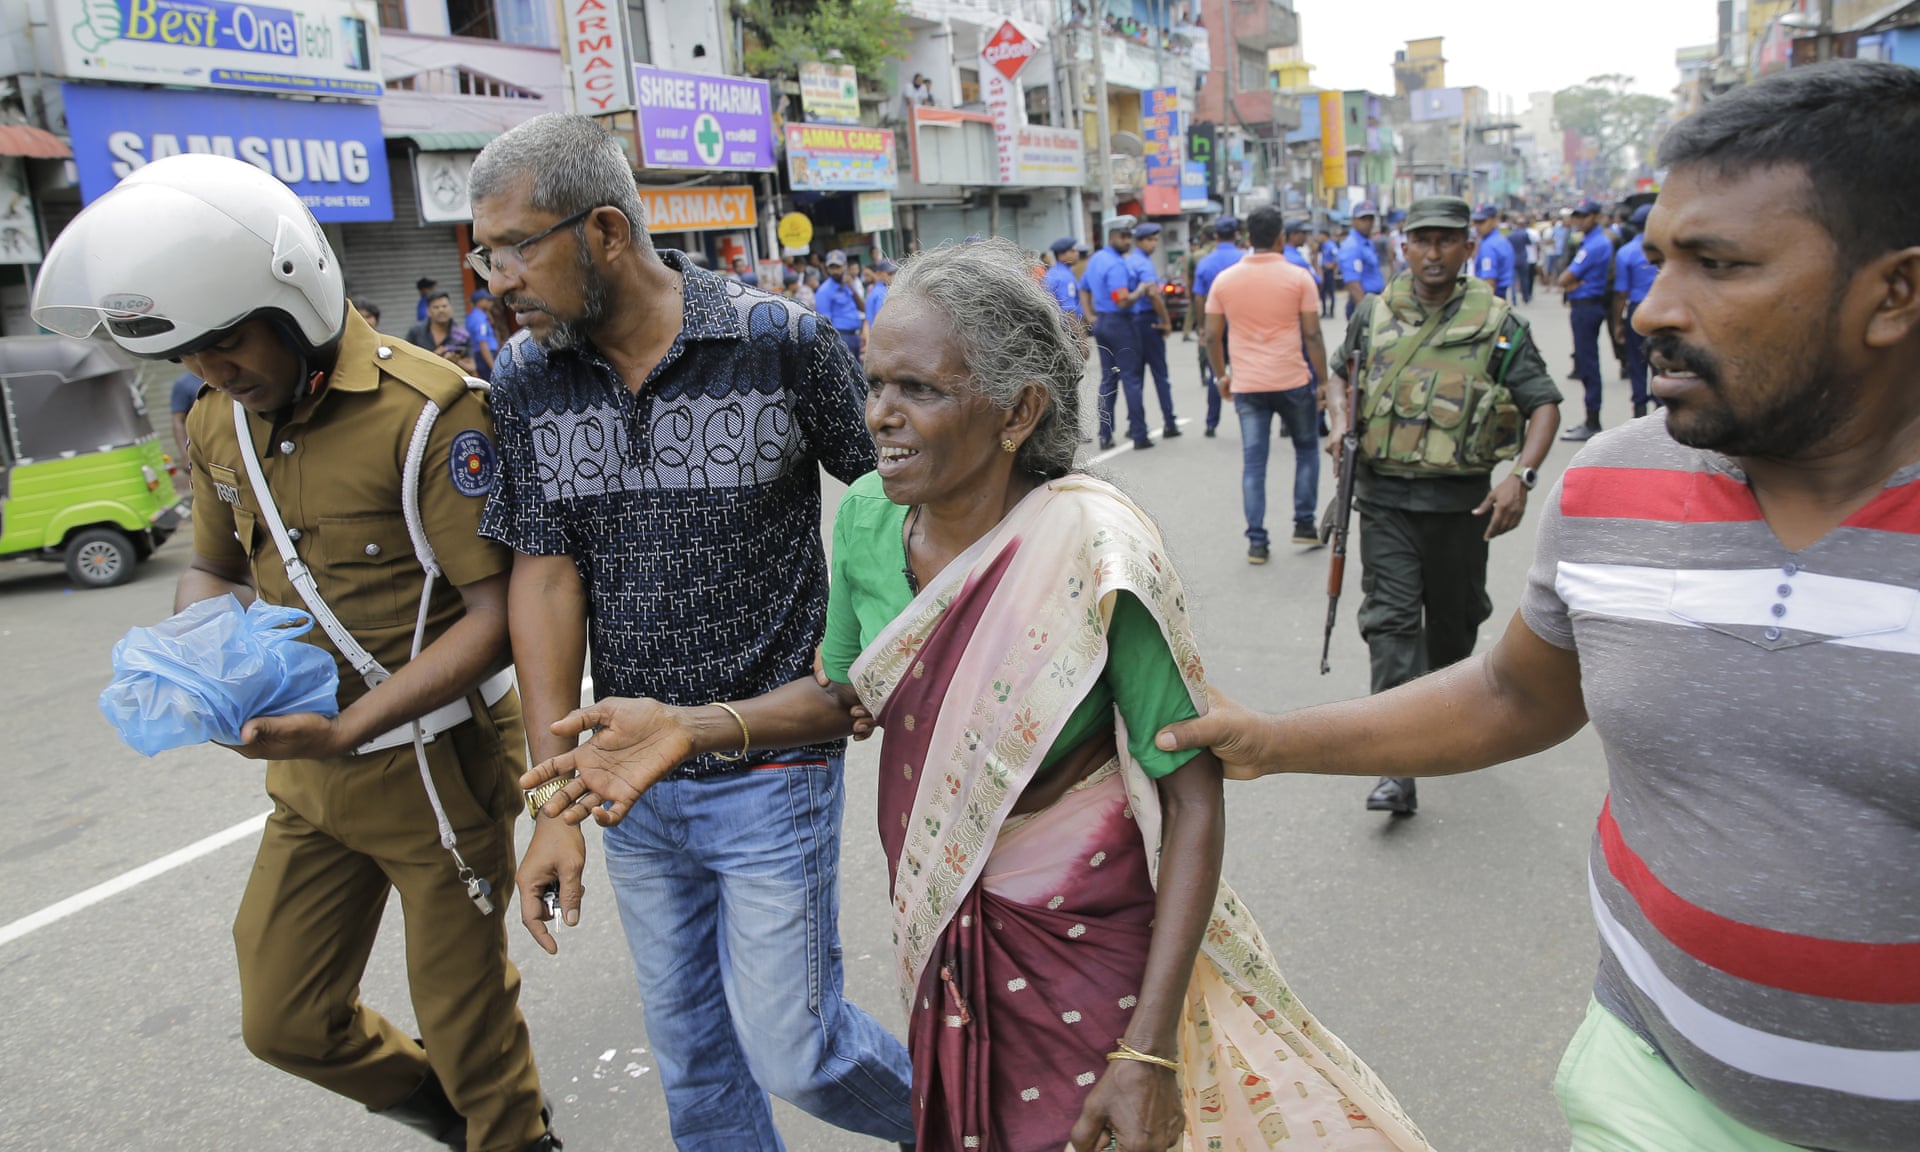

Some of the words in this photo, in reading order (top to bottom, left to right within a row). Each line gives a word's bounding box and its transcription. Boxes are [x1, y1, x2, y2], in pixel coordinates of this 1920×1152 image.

[641, 75, 697, 111] SHREE
[699, 81, 763, 116] PHARMA
[802, 127, 847, 149] AMMA
